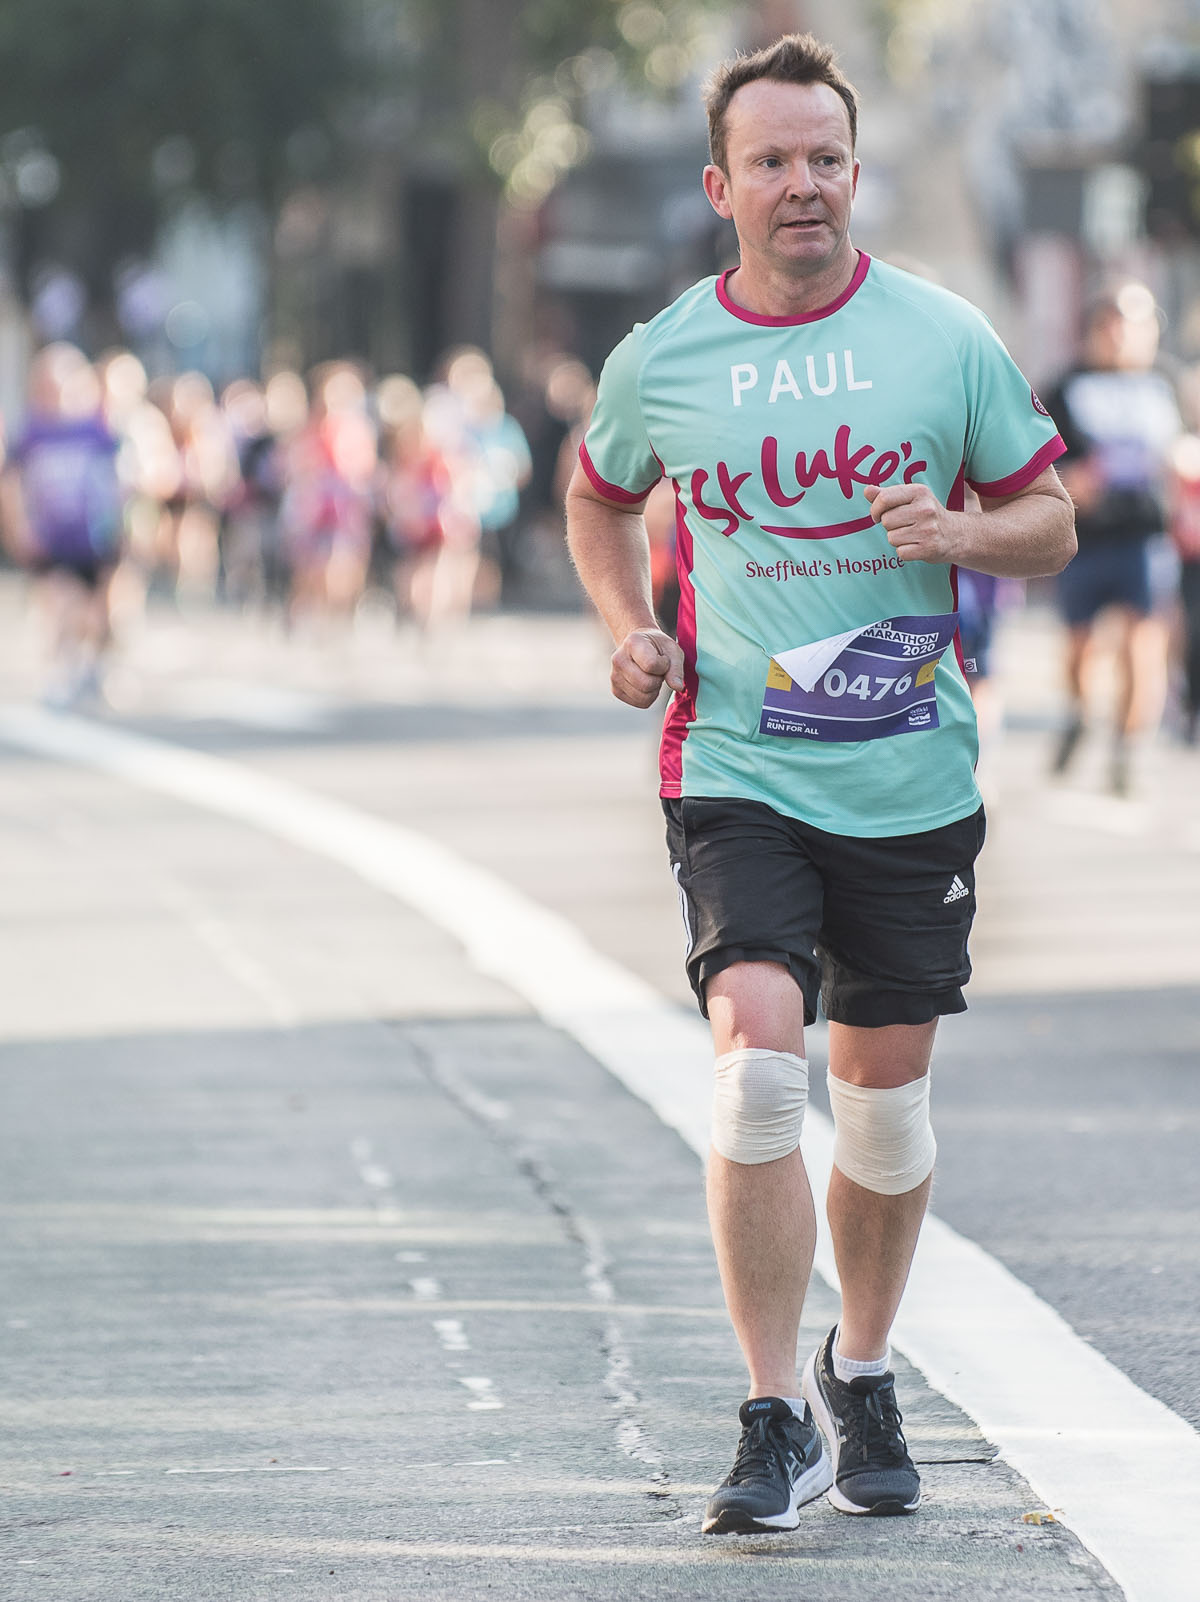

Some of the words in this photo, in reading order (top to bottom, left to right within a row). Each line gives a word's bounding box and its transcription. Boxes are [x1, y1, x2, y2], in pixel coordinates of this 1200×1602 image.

[730, 350, 873, 407] PAUL
[745, 560, 832, 582] Sheffield's
[836, 553, 905, 575] Hospice
[863, 629, 939, 645] MARATHON
[902, 643, 937, 656] 2020
[823, 668, 912, 701] 0476
[766, 721, 785, 731] RUN
[786, 724, 803, 733] FOR
[804, 727, 820, 735] ALL
[943, 887, 970, 904] adidas
